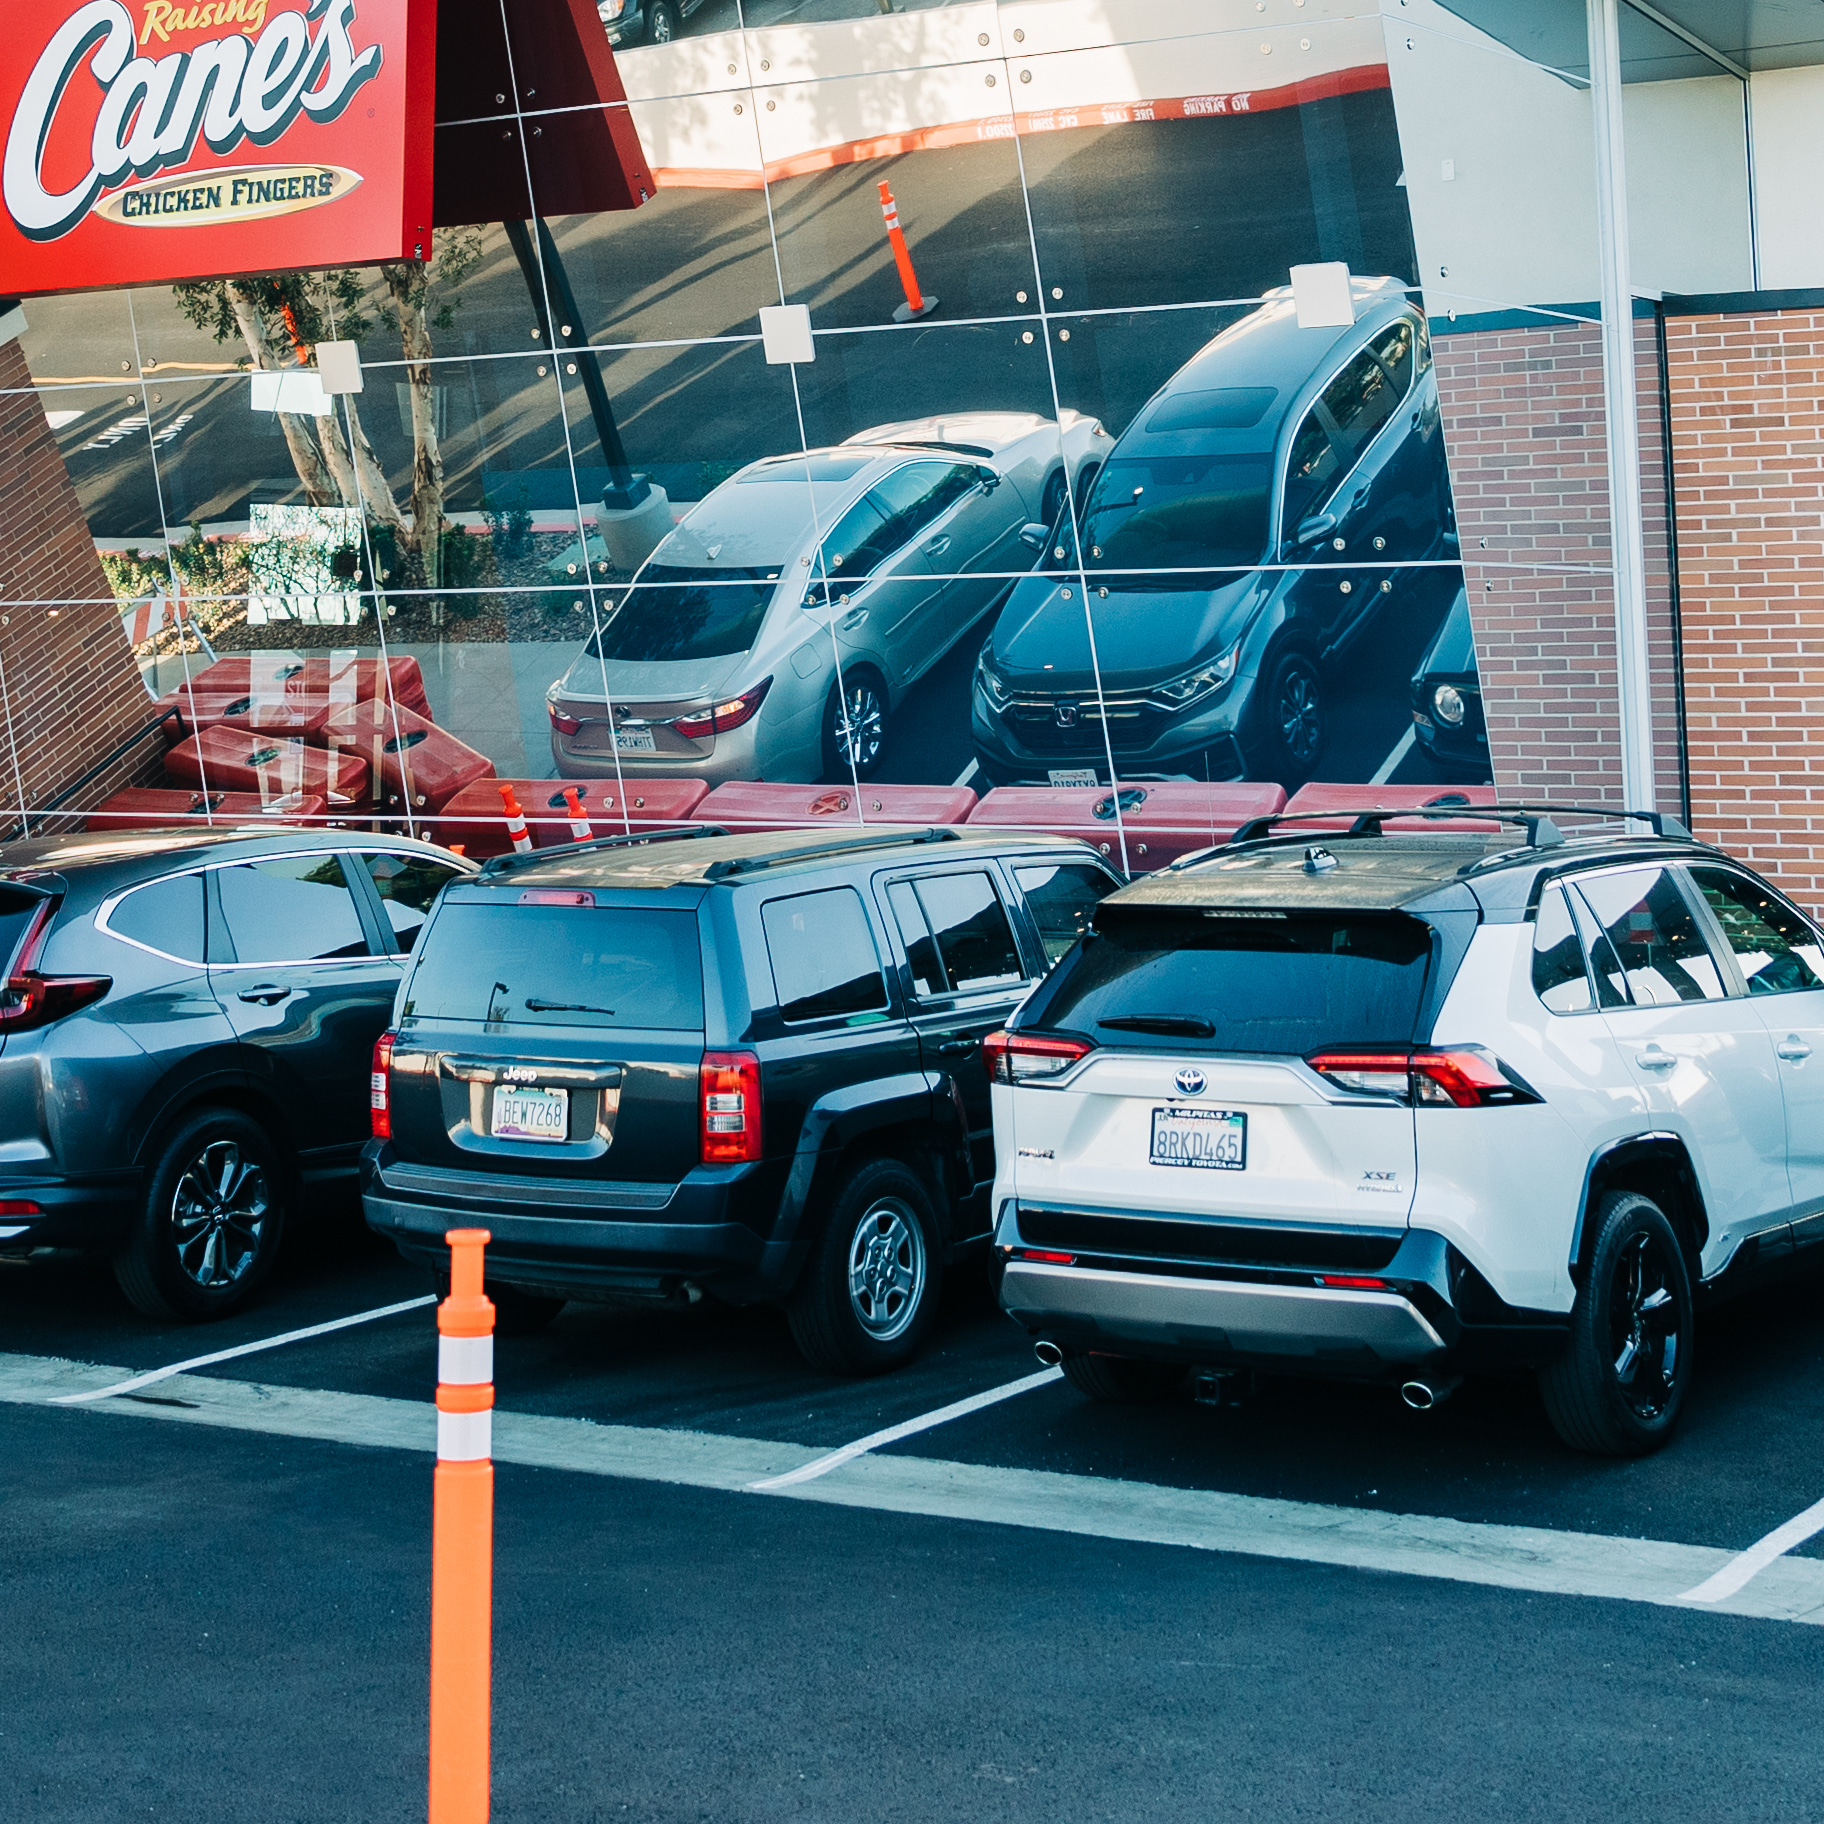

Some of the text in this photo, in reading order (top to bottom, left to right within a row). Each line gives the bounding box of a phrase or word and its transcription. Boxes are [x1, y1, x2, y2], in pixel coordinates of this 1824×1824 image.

[502, 1065, 538, 1082] Jeep
[504, 1100, 562, 1128] BEW7268
[1156, 1130, 1238, 1162] 8RKD465
[1362, 1170, 1397, 1181] XSE
